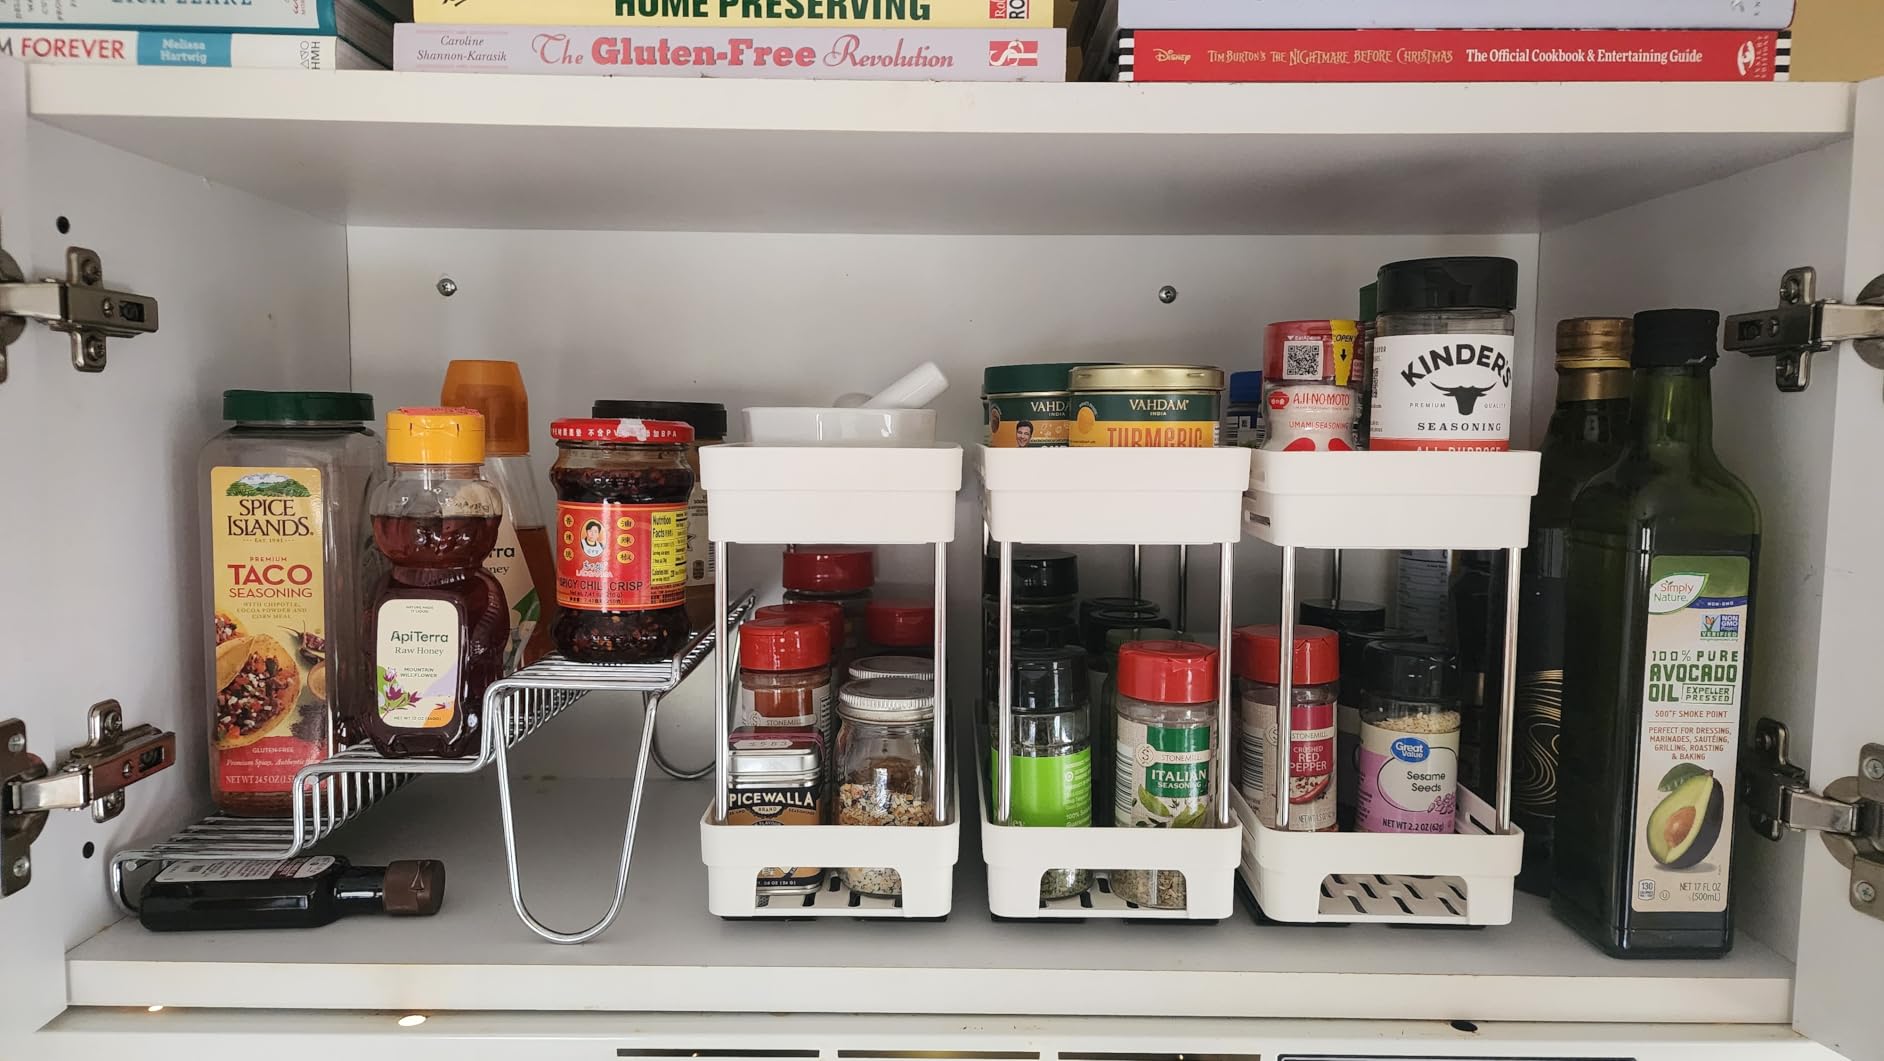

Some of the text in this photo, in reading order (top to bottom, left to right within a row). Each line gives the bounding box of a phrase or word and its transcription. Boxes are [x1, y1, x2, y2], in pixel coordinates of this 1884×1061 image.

[162, 38, 206, 50] Melissa
[440, 35, 484, 47] Caroline
[21, 37, 125, 59] FOREVER
[531, 34, 954, 68] The Gluten-Free Revolution
[160, 51, 208, 64] Hartwig
[310, 41, 321, 70] HMH
[416, 49, 507, 63] Shannon-Karasik
[1153, 48, 1191, 65] Disney
[1270, 51, 1287, 62] THE
[1289, 49, 1351, 65] NIGHTMARE
[1354, 49, 1392, 62] BEFORE
[1396, 48, 1453, 64] CHRISTMAS
[1466, 48, 1487, 62] The
[1489, 48, 1530, 62] Official
[1531, 48, 1584, 62] Cookbook
[1587, 50, 1595, 62] &
[1597, 48, 1668, 64] Entertaining
[1669, 49, 1703, 63] Guide
[1336, 334, 1354, 343] OPEN
[1401, 344, 1511, 389] KINDER'S
[1129, 400, 1187, 411] VAHDAM
[1289, 421, 1314, 429] UMAMI
[1417, 422, 1502, 432] SEASONING
[239, 499, 296, 516] SPICE
[227, 516, 310, 536] ISLANDS
[227, 564, 313, 585] TACO
[610, 581, 643, 591] CRISP
[1660, 582, 1694, 595] Simply
[229, 588, 313, 598] SEASONING
[390, 631, 449, 644] ApiTerra
[394, 647, 444, 656] Raw Honey
[1652, 650, 1739, 661] 100% PURE
[1649, 664, 1738, 683] AVOCADO
[1648, 683, 1730, 702] OIL EXPELLER
[1678, 710, 1704, 718] SMOKE
[1707, 710, 1729, 718] POINT
[1648, 727, 1732, 736] PERFECT FOR DRESSING,
[1649, 736, 1692, 744] MARINADES,
[1293, 745, 1324, 753] CRUSHED
[1396, 742, 1424, 752] Great
[1654, 744, 1724, 753] GRILLING, ROASTING
[1298, 752, 1320, 762] RED
[1402, 750, 1424, 758] Value
[1672, 753, 1706, 761] & BAKING
[226, 775, 242, 784] NET
[242, 775, 254, 784] WT
[269, 775, 280, 784] OZ
[1151, 769, 1207, 781] ITALIAN
[1407, 771, 1446, 781] Sesame
[1157, 781, 1201, 789] SEASONG
[1411, 783, 1442, 792] Seeds
[1383, 819, 1395, 827] NET
[1396, 821, 1407, 829] WT
[1408, 822, 1419, 830] 2.2
[1421, 822, 1430, 830] OZ
[1641, 882, 1653, 890] 130
[1680, 882, 1721, 891] NET 17 FL OZ
[1692, 891, 1721, 902] (500mL)
